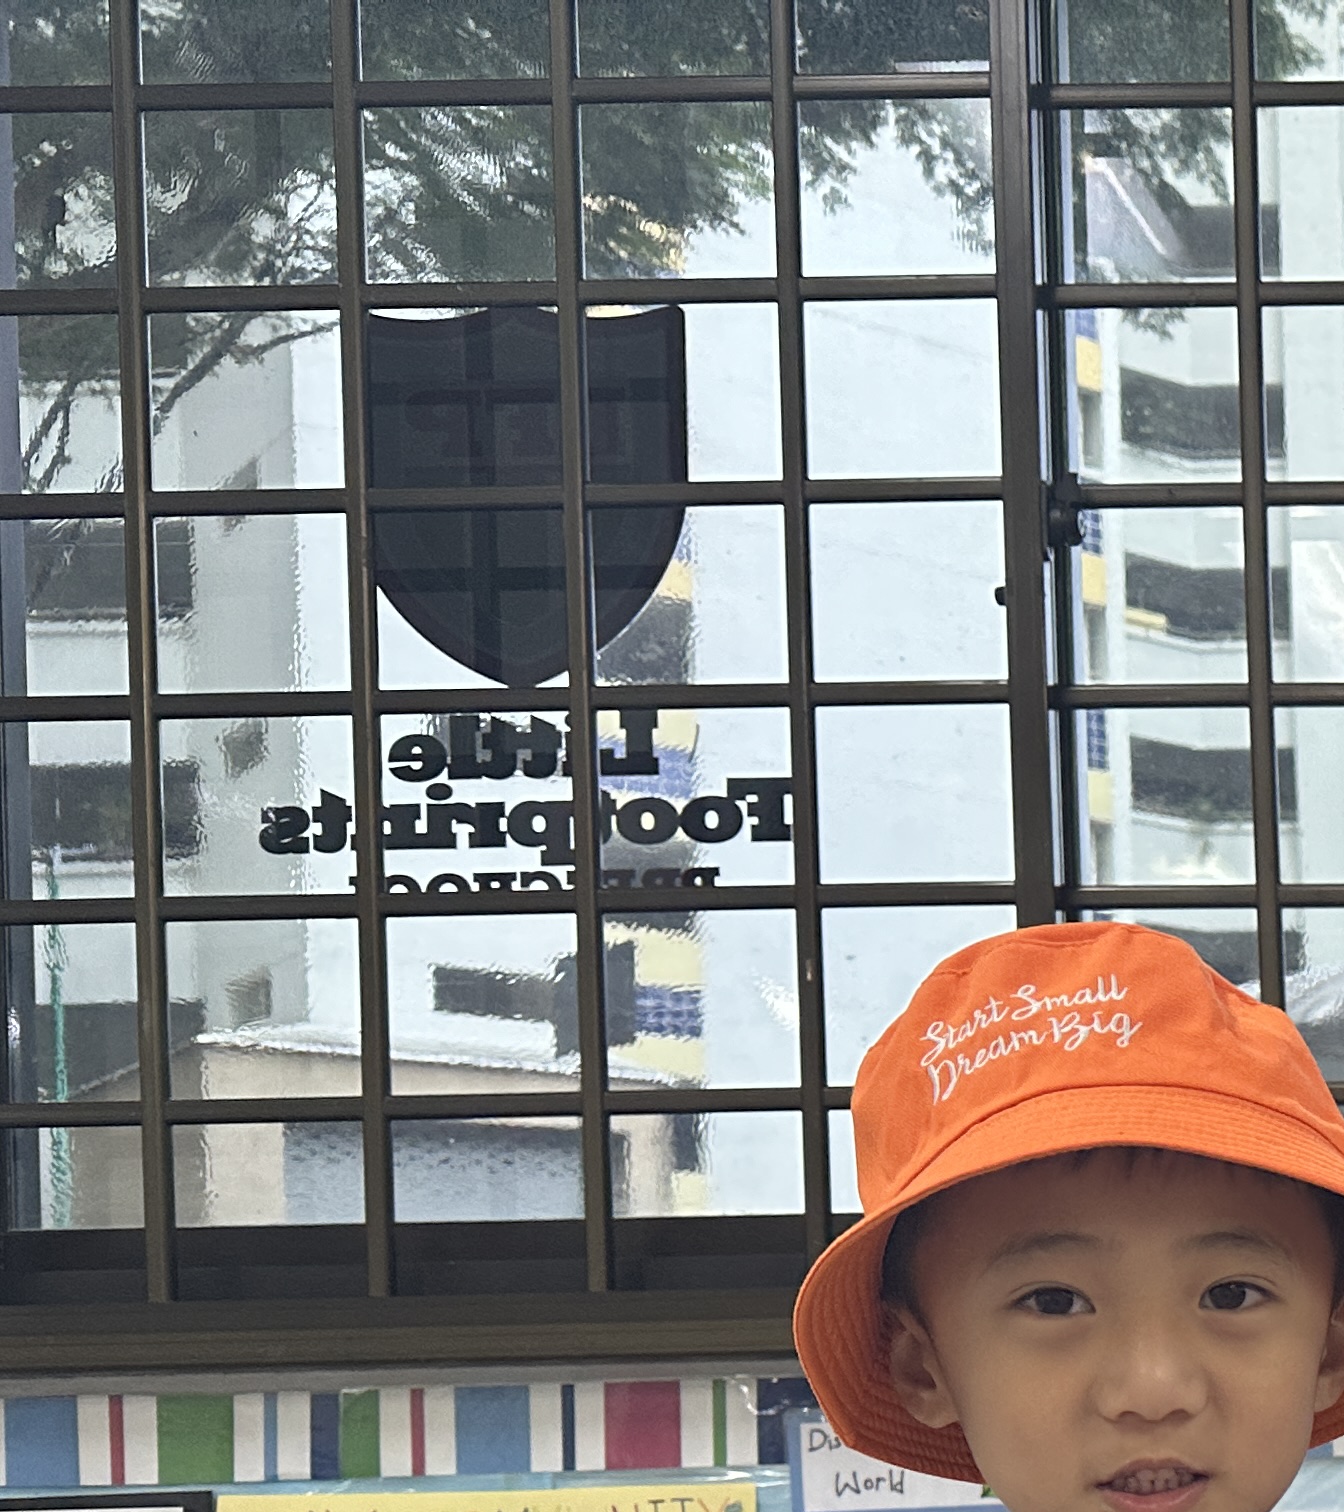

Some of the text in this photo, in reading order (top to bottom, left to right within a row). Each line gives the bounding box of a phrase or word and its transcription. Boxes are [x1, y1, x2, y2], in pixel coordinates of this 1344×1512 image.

[920, 974, 1129, 1067] Start Small
[926, 1011, 1143, 1106] Dream Big
[834, 1469, 905, 1498] World
